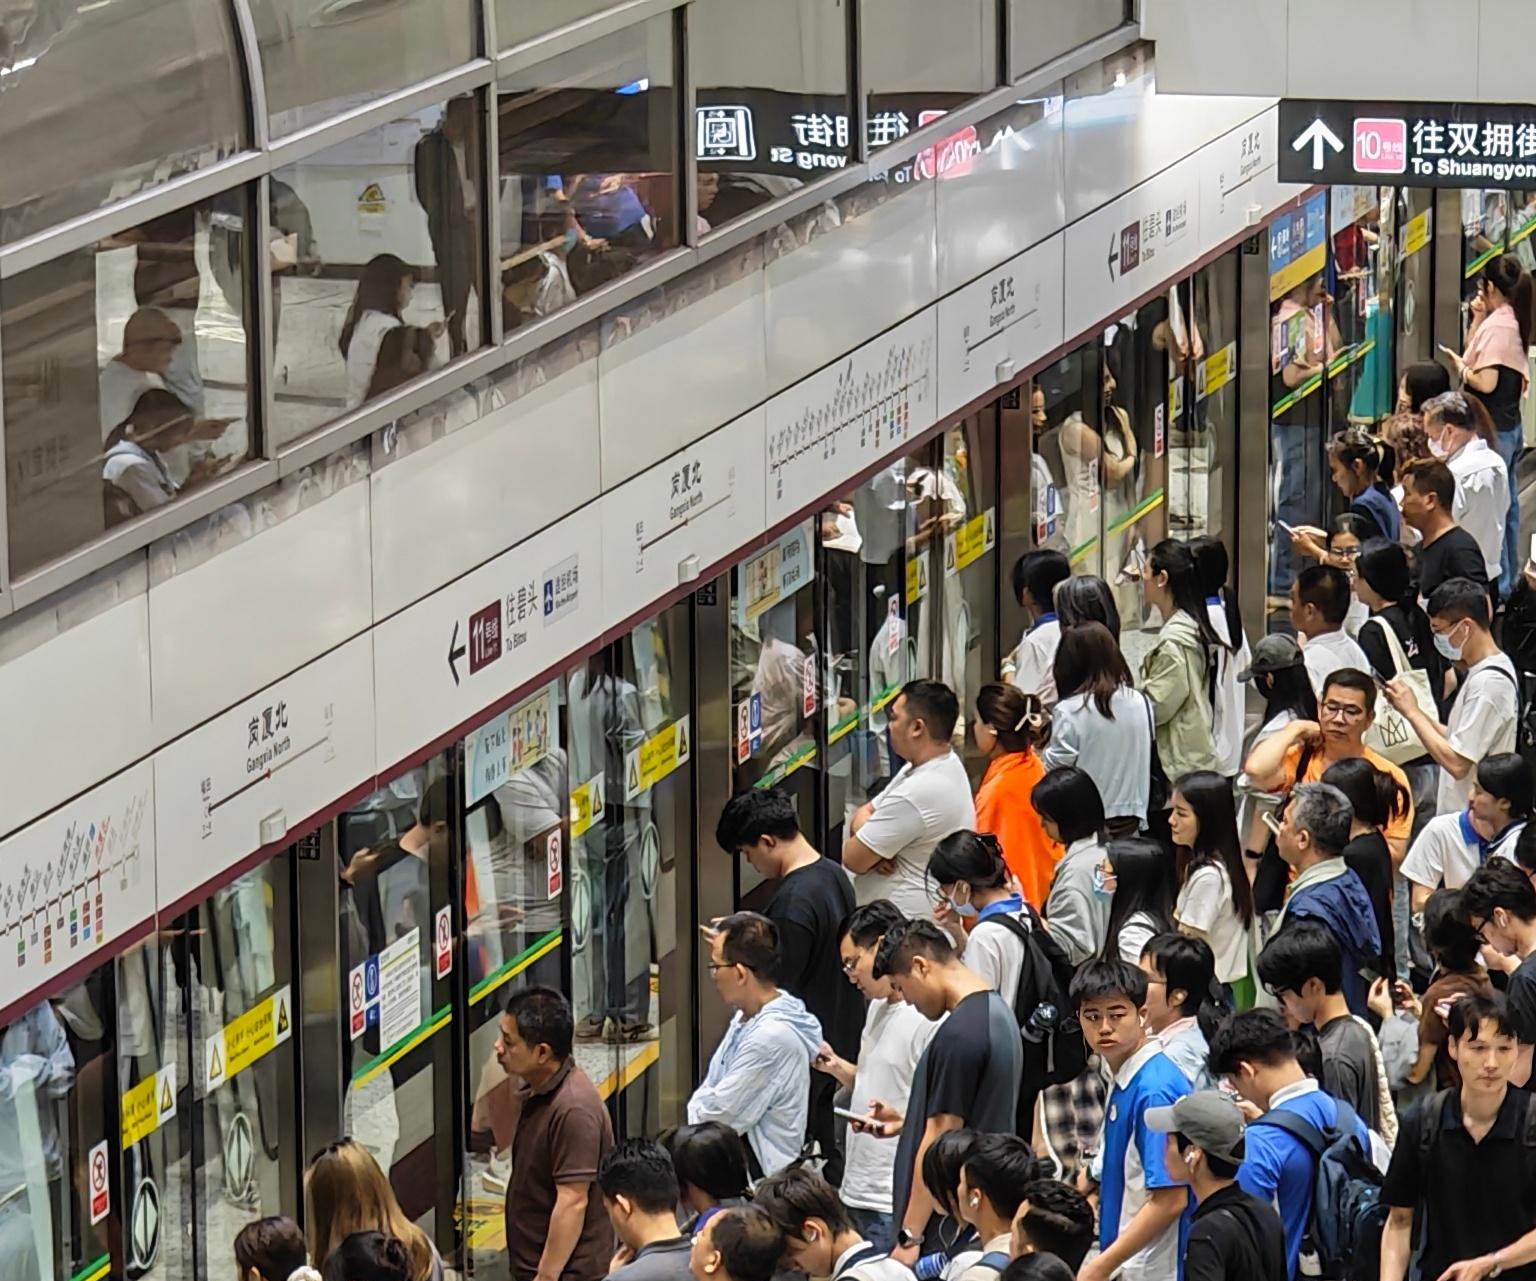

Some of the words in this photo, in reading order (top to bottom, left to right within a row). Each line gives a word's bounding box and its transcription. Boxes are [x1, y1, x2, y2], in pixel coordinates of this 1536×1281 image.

[1356, 131, 1380, 160] 10
[1411, 158, 1433, 175] To
[472, 617, 485, 664] 11
[247, 699, 289, 750] 岗厦北
[246, 749, 272, 774] Gangxia
[272, 736, 291, 758] North
